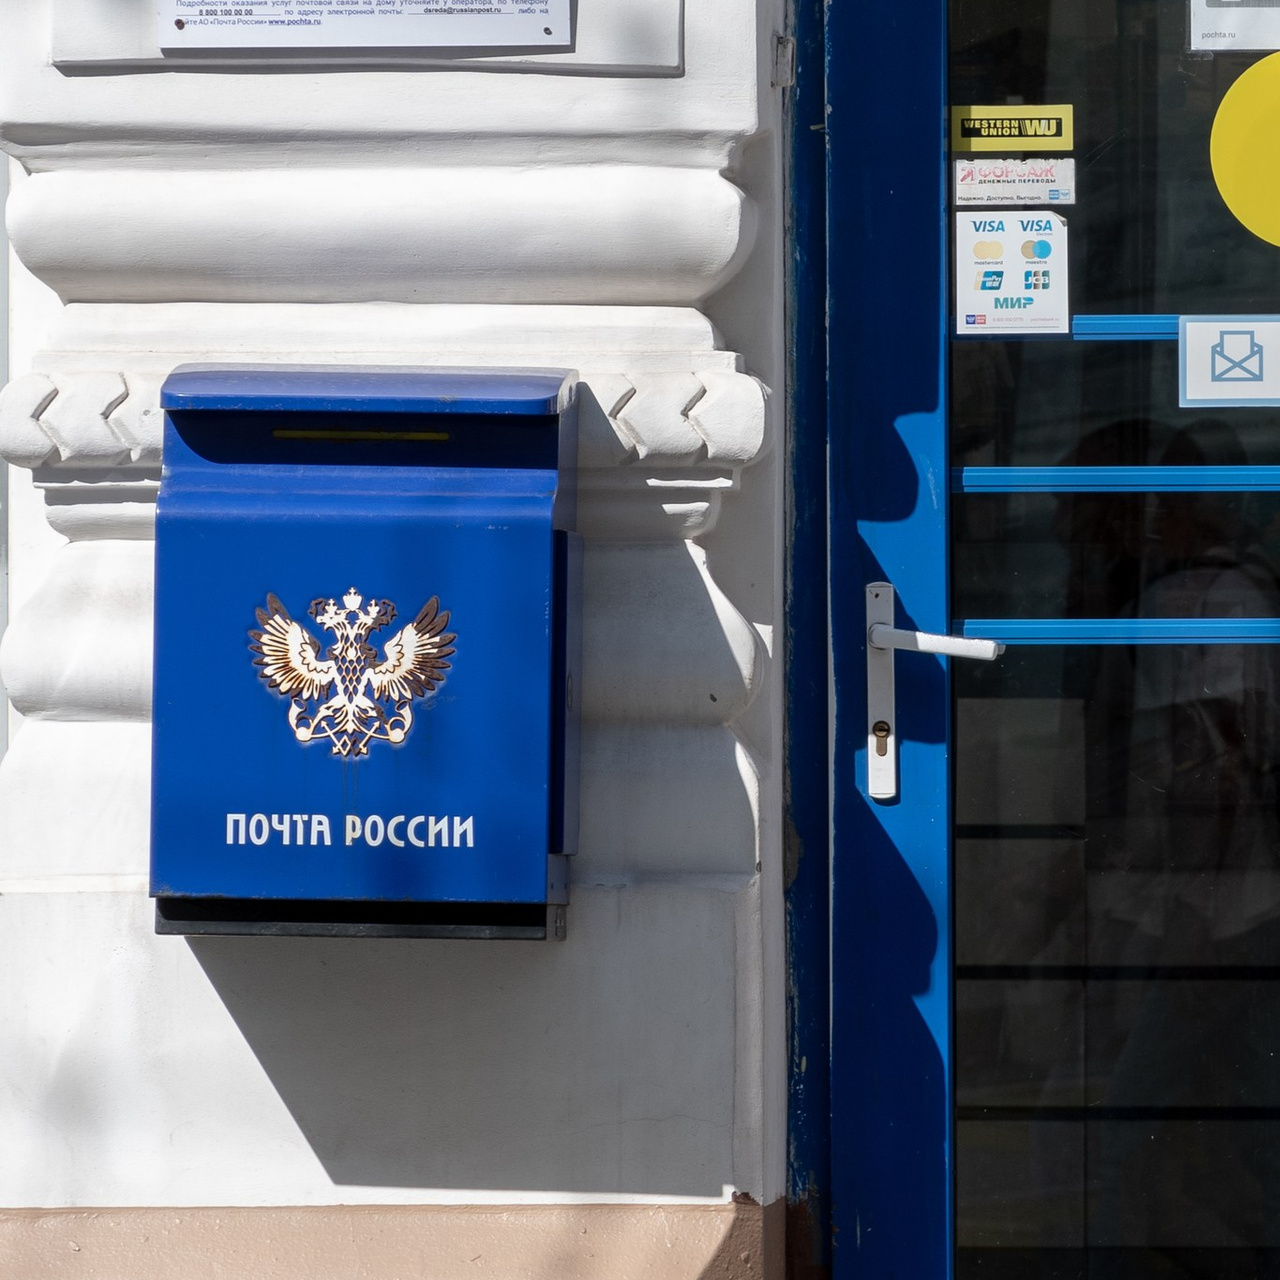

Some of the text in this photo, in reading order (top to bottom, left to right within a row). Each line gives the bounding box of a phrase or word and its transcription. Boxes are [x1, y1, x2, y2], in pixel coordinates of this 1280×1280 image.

[1201, 31, 1236, 40] pochta.ru
[965, 120, 1019, 128] WESTERN
[1025, 120, 1056, 135] WU
[971, 220, 1005, 232] VISA
[1018, 220, 1052, 232] VISA
[994, 297, 1034, 309] МИР
[226, 813, 474, 847] ПОЧТА РОССИИ
